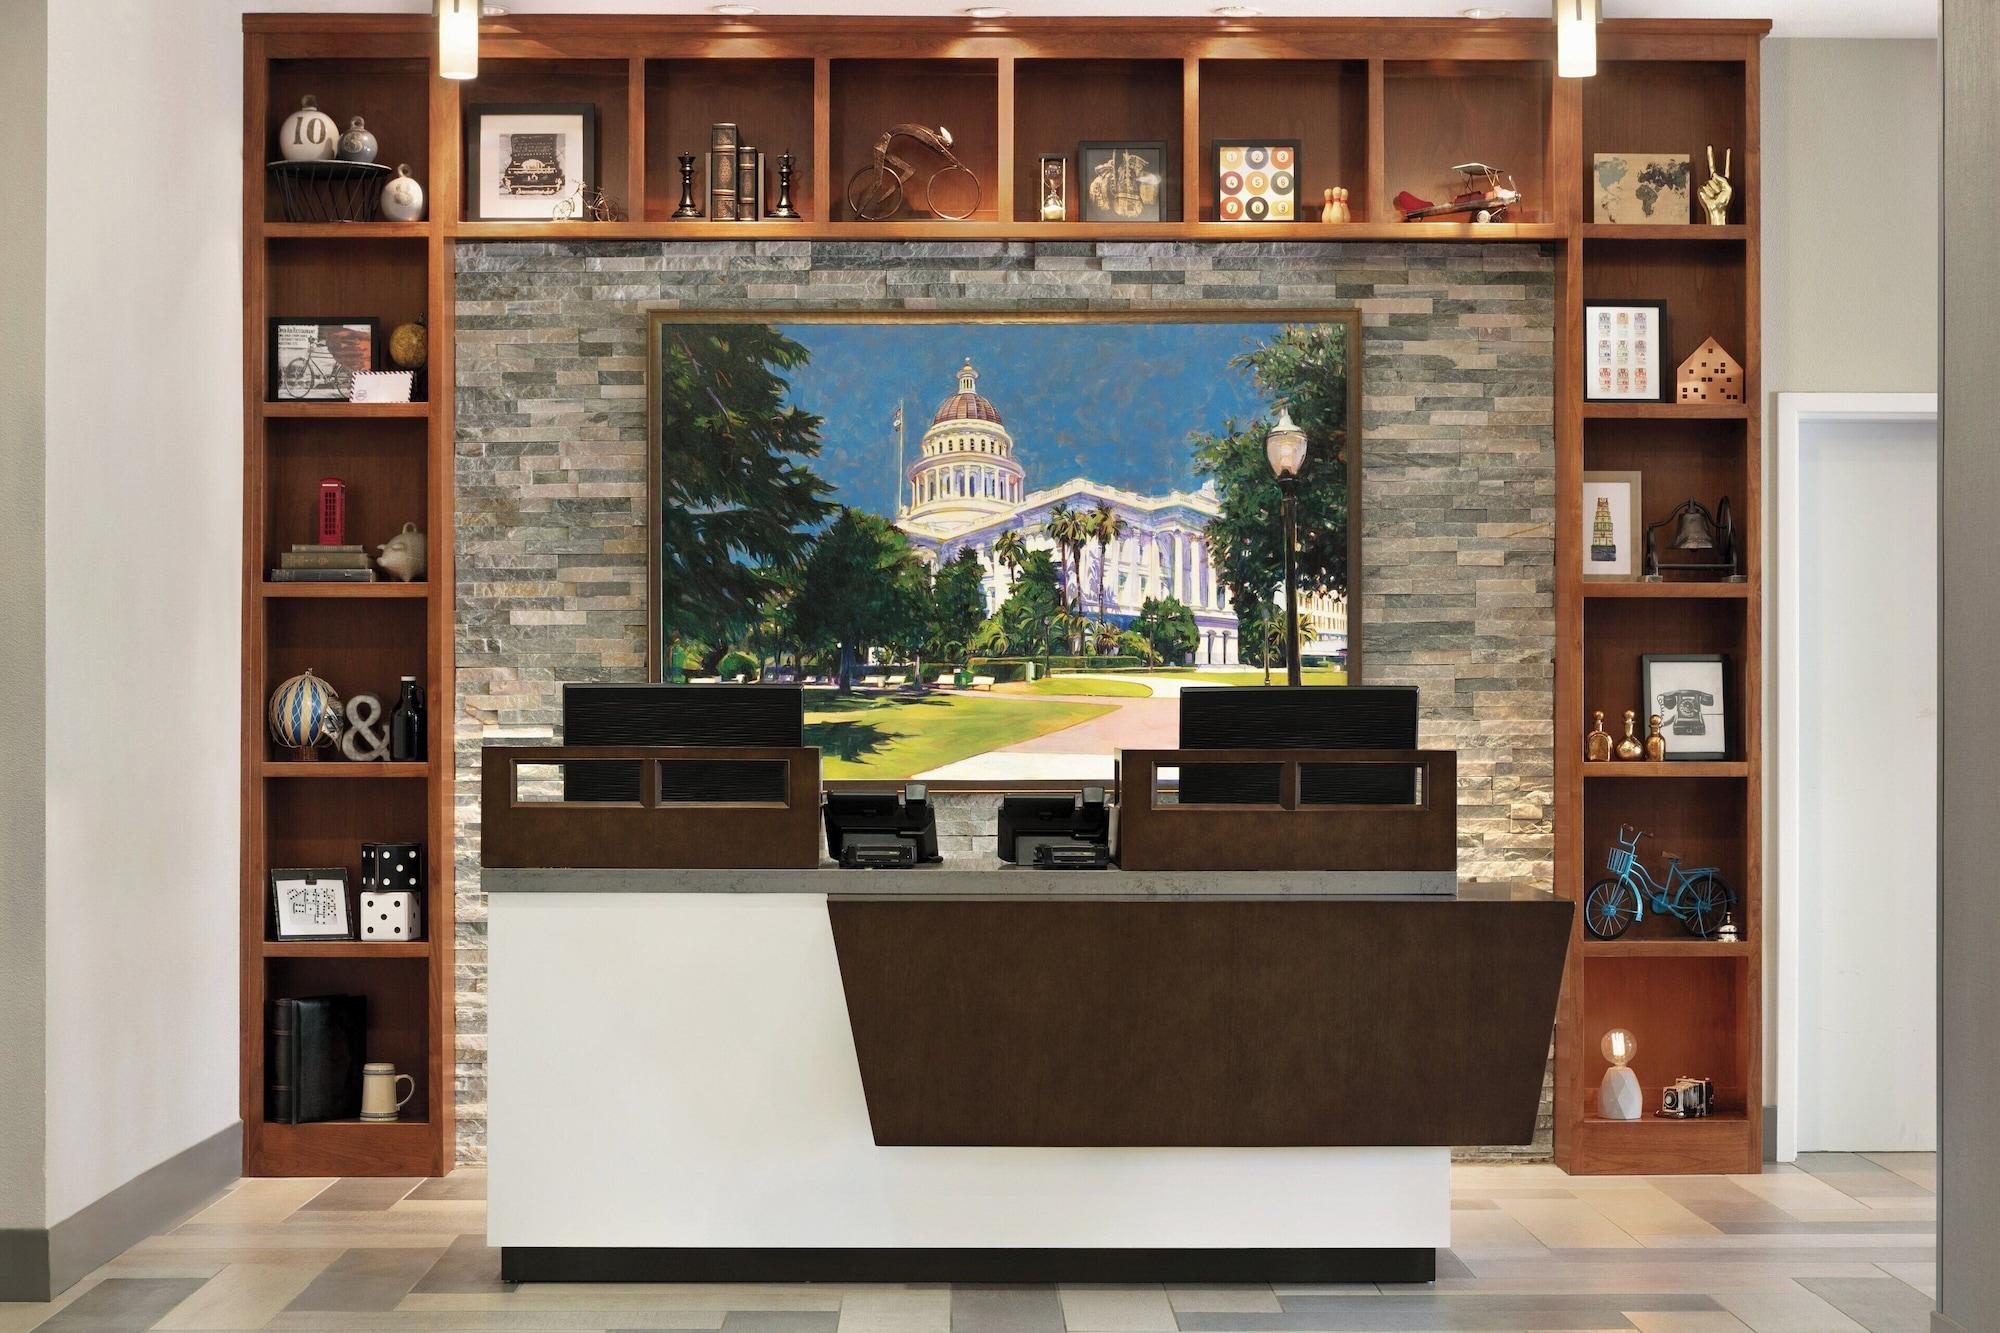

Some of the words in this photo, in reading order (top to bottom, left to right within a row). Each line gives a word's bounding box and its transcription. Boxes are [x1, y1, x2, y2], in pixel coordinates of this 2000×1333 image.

[293, 116, 326, 145] 10
[1255, 153, 1260, 161] 2
[1280, 153, 1286, 161] 3
[1229, 178, 1235, 186] 4
[1255, 178, 1260, 186] 5
[1281, 178, 1286, 186] 6
[1230, 204, 1235, 212] 7
[1255, 204, 1260, 212] 8
[1281, 204, 1286, 212] 9
[342, 694, 391, 761] &
